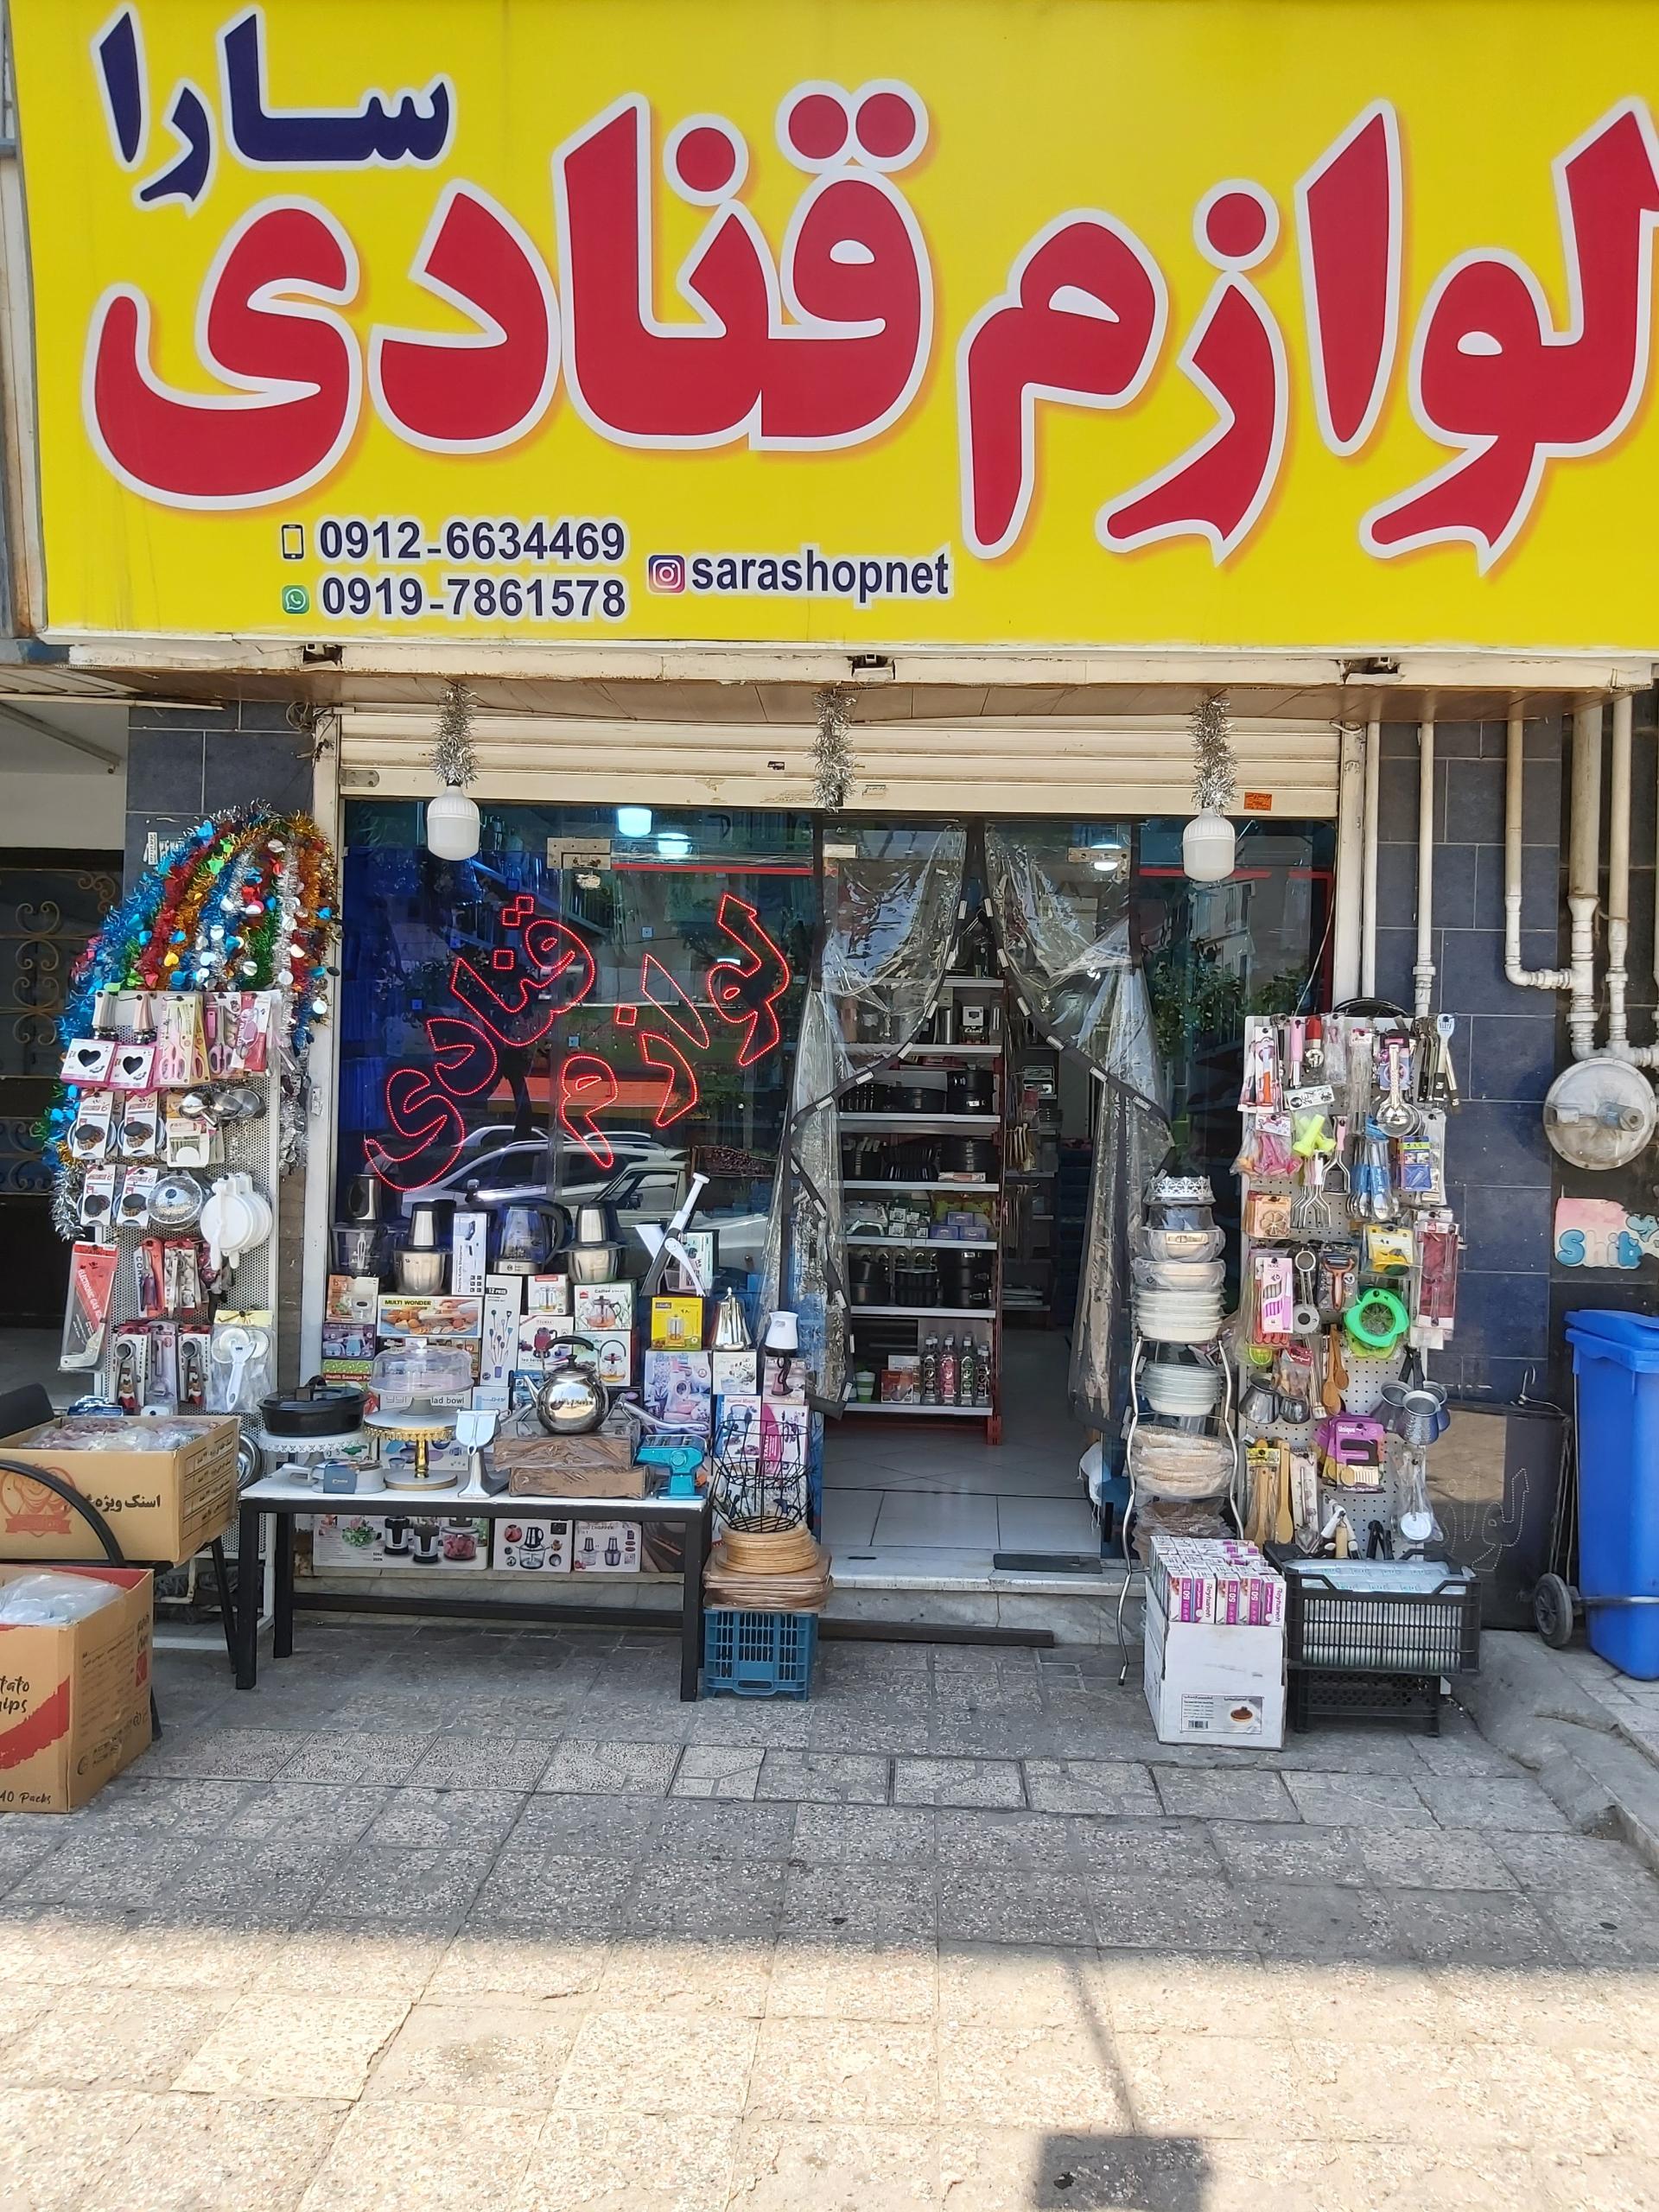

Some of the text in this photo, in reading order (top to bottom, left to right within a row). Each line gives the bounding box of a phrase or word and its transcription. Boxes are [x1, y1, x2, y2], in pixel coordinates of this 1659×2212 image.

[95, 5, 454, 213] سارا
[88, 84, 1659, 569] لوازم قنادی
[318, 520, 626, 561] 0912-6634469
[321, 576, 627, 618] 0919-7861578
[690, 549, 950, 604] sarashopnet
[364, 892, 791, 1192] لوازم قنادی
[431, 1395, 465, 1404] lad bowl
[0, 1675, 30, 1695] tato
[0, 1697, 29, 1715] ips
[19, 1791, 52, 1805] Packs
